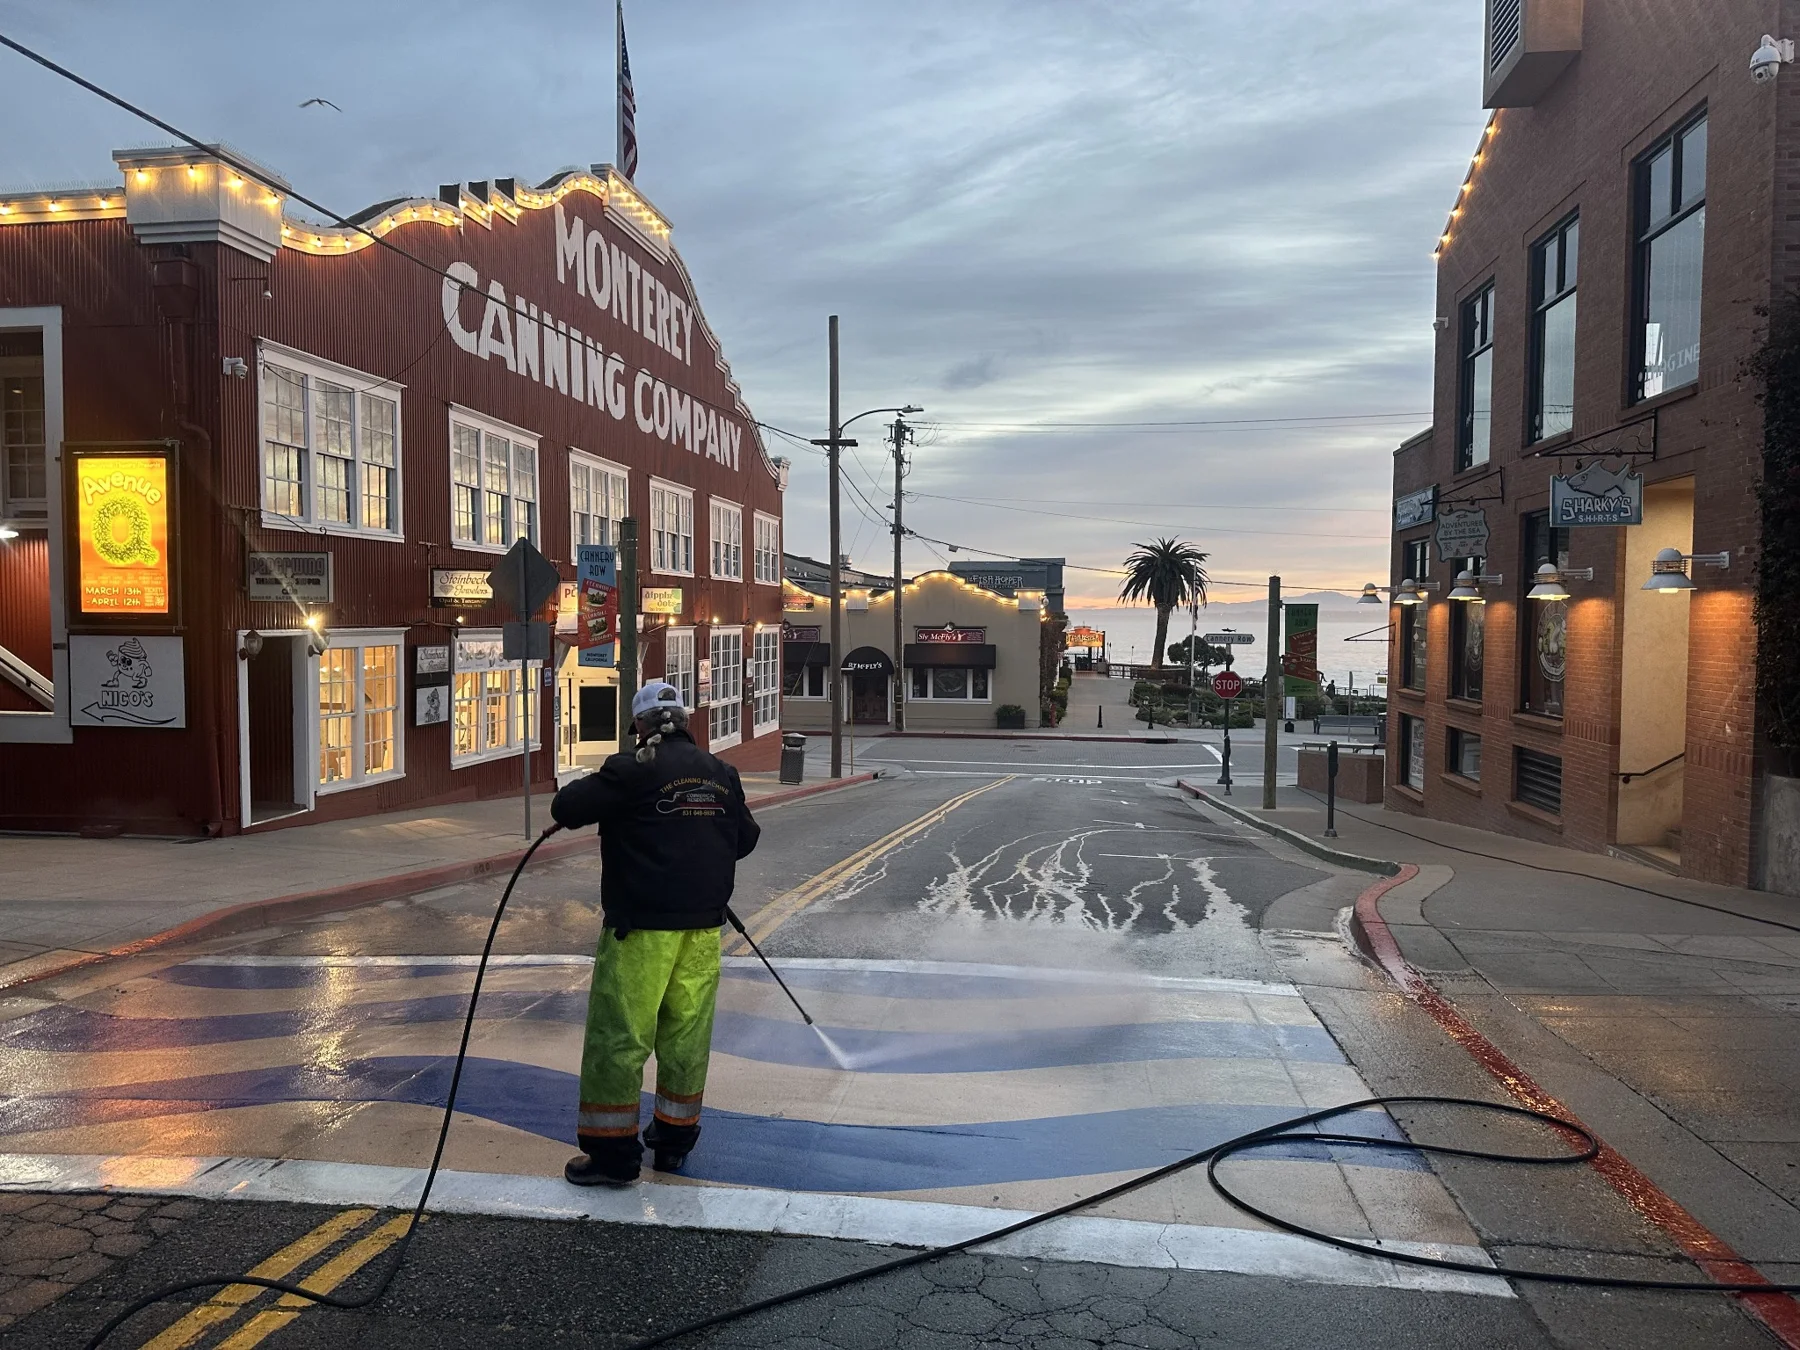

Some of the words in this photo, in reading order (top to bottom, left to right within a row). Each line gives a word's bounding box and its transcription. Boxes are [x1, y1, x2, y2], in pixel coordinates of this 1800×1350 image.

[555, 203, 693, 366] MONTEREY
[442, 261, 626, 421] CANNING
[634, 367, 741, 472] COMPANY
[82, 471, 162, 506] Avenue
[1562, 495, 1632, 520] SHARKY'S
[1441, 520, 1483, 529] ADVENTURES
[91, 496, 160, 567] Q
[580, 550, 614, 563] CANNERY
[588, 564, 606, 576] ROW
[439, 571, 487, 585] Steinbeck
[85, 587, 119, 595] MARCH
[124, 587, 142, 595] 13th
[454, 585, 488, 596] Jewelers
[123, 597, 141, 606] 12th
[1206, 634, 1234, 643] Cannery
[1215, 680, 1240, 690] STOP
[101, 690, 154, 708] NICO'S
[660, 782, 674, 794] THE
[673, 777, 702, 787] CLEANING
[702, 779, 730, 796] MACHINE
